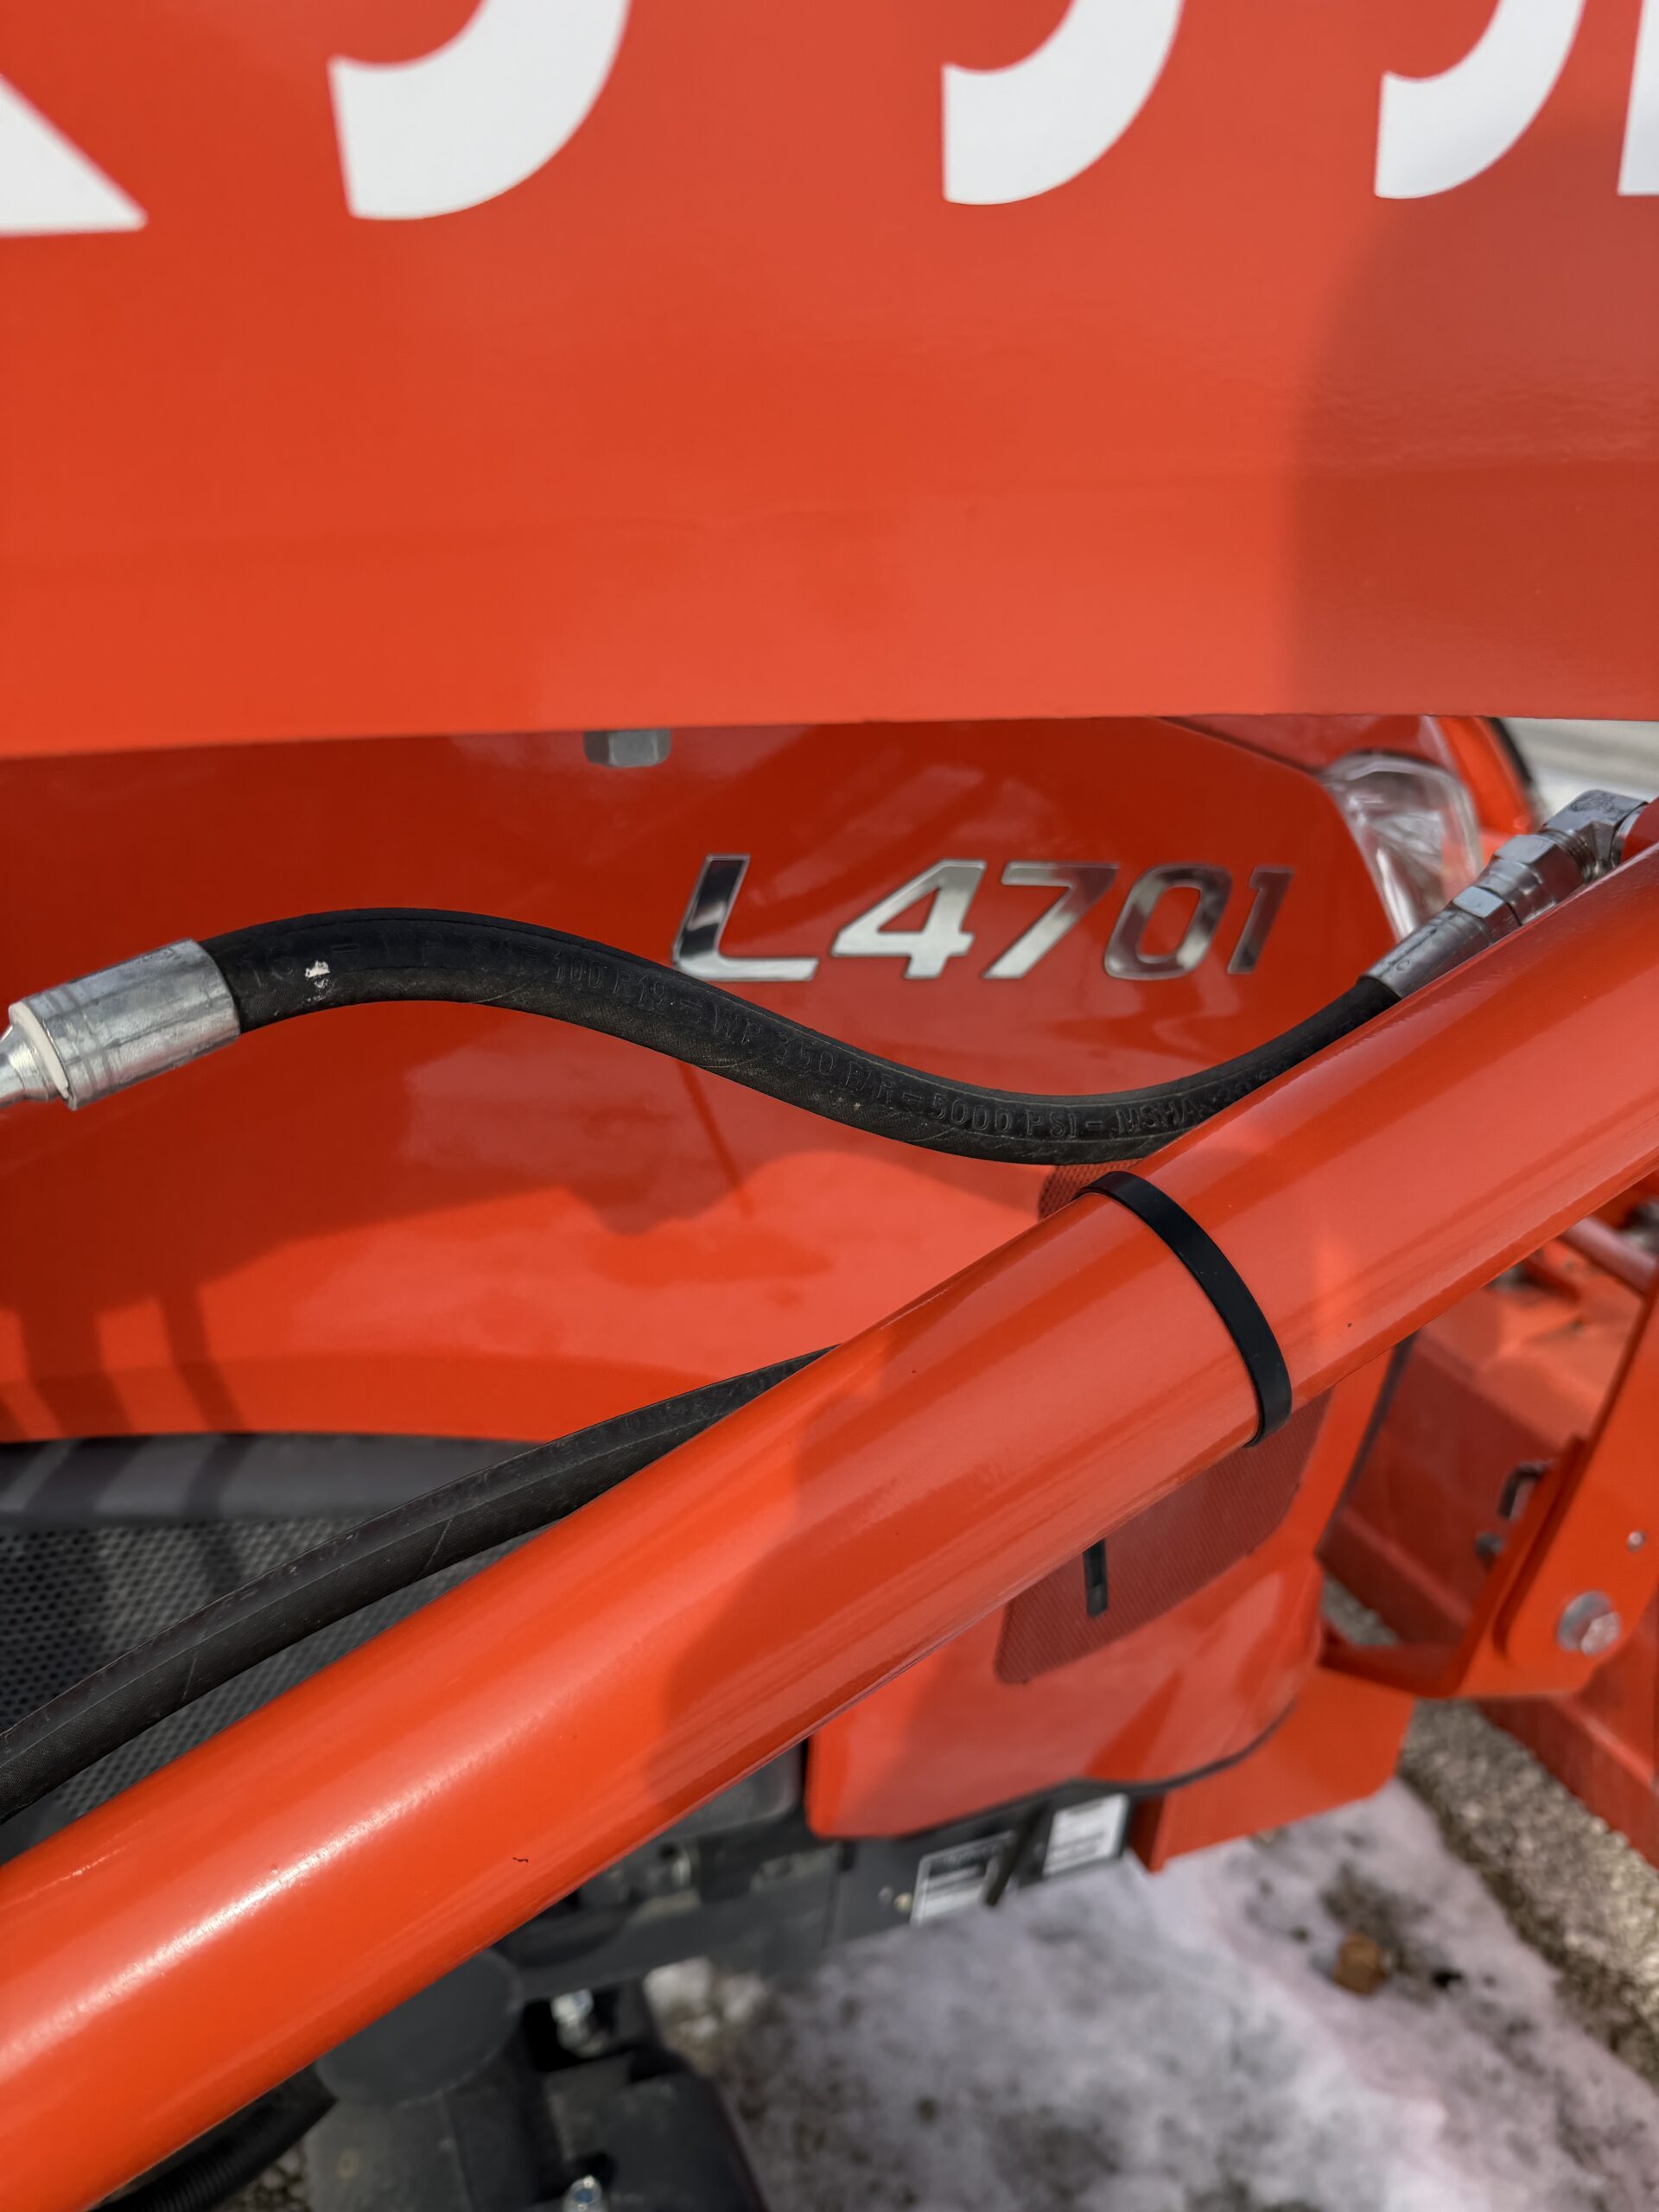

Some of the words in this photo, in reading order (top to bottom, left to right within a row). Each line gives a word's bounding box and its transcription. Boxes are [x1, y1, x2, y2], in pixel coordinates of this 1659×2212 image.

[671, 853, 1294, 982] L4701
[553, 949, 604, 988] 100
[932, 1091, 1013, 1134] 5000
[1025, 1109, 1079, 1141] PSI
